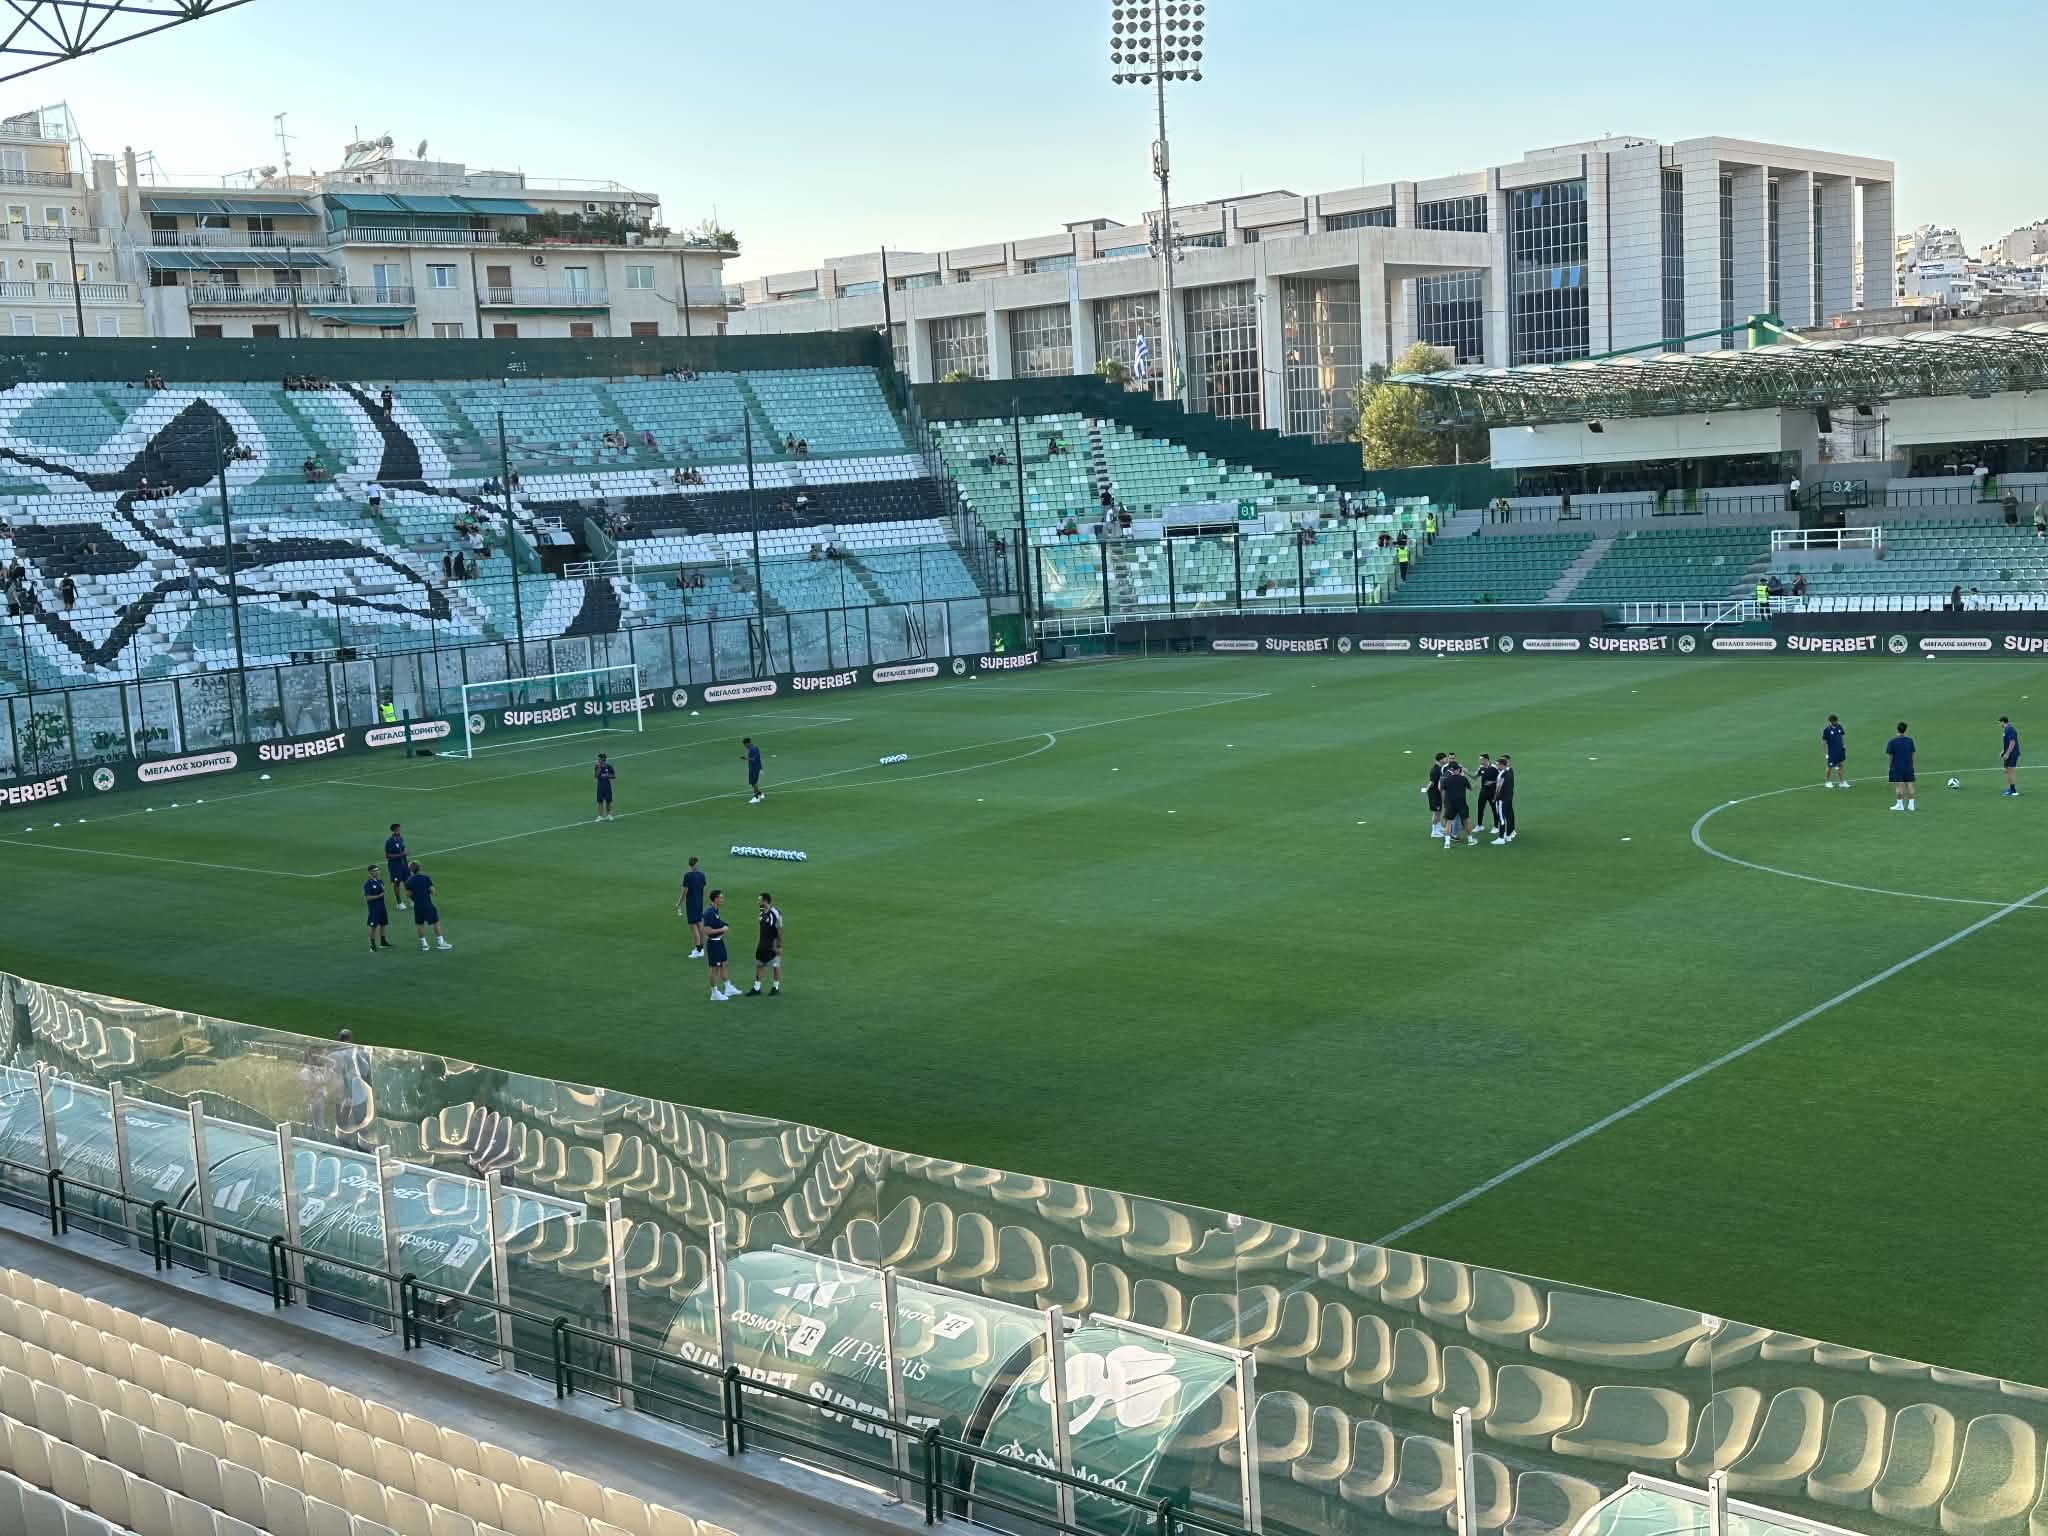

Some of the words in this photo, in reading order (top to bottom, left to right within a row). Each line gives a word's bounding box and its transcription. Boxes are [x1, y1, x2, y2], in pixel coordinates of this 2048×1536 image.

[1265, 637, 1329, 652] SUPERBET
[1418, 636, 1490, 652] SUPERBET
[1588, 636, 1668, 652] SUPERBET
[1786, 635, 1877, 652] SUPERBET
[980, 651, 1038, 669] SUPERBET
[792, 670, 858, 691] SUPERBET
[503, 703, 577, 726] SUPERBET
[259, 733, 345, 761] SUPERBET
[144, 762, 188, 776] ΜΕΓΑΛΟΣ
[190, 756, 232, 769] ΧΟΡΗΓΟΣ
[731, 1310, 790, 1336] COSMOTE
